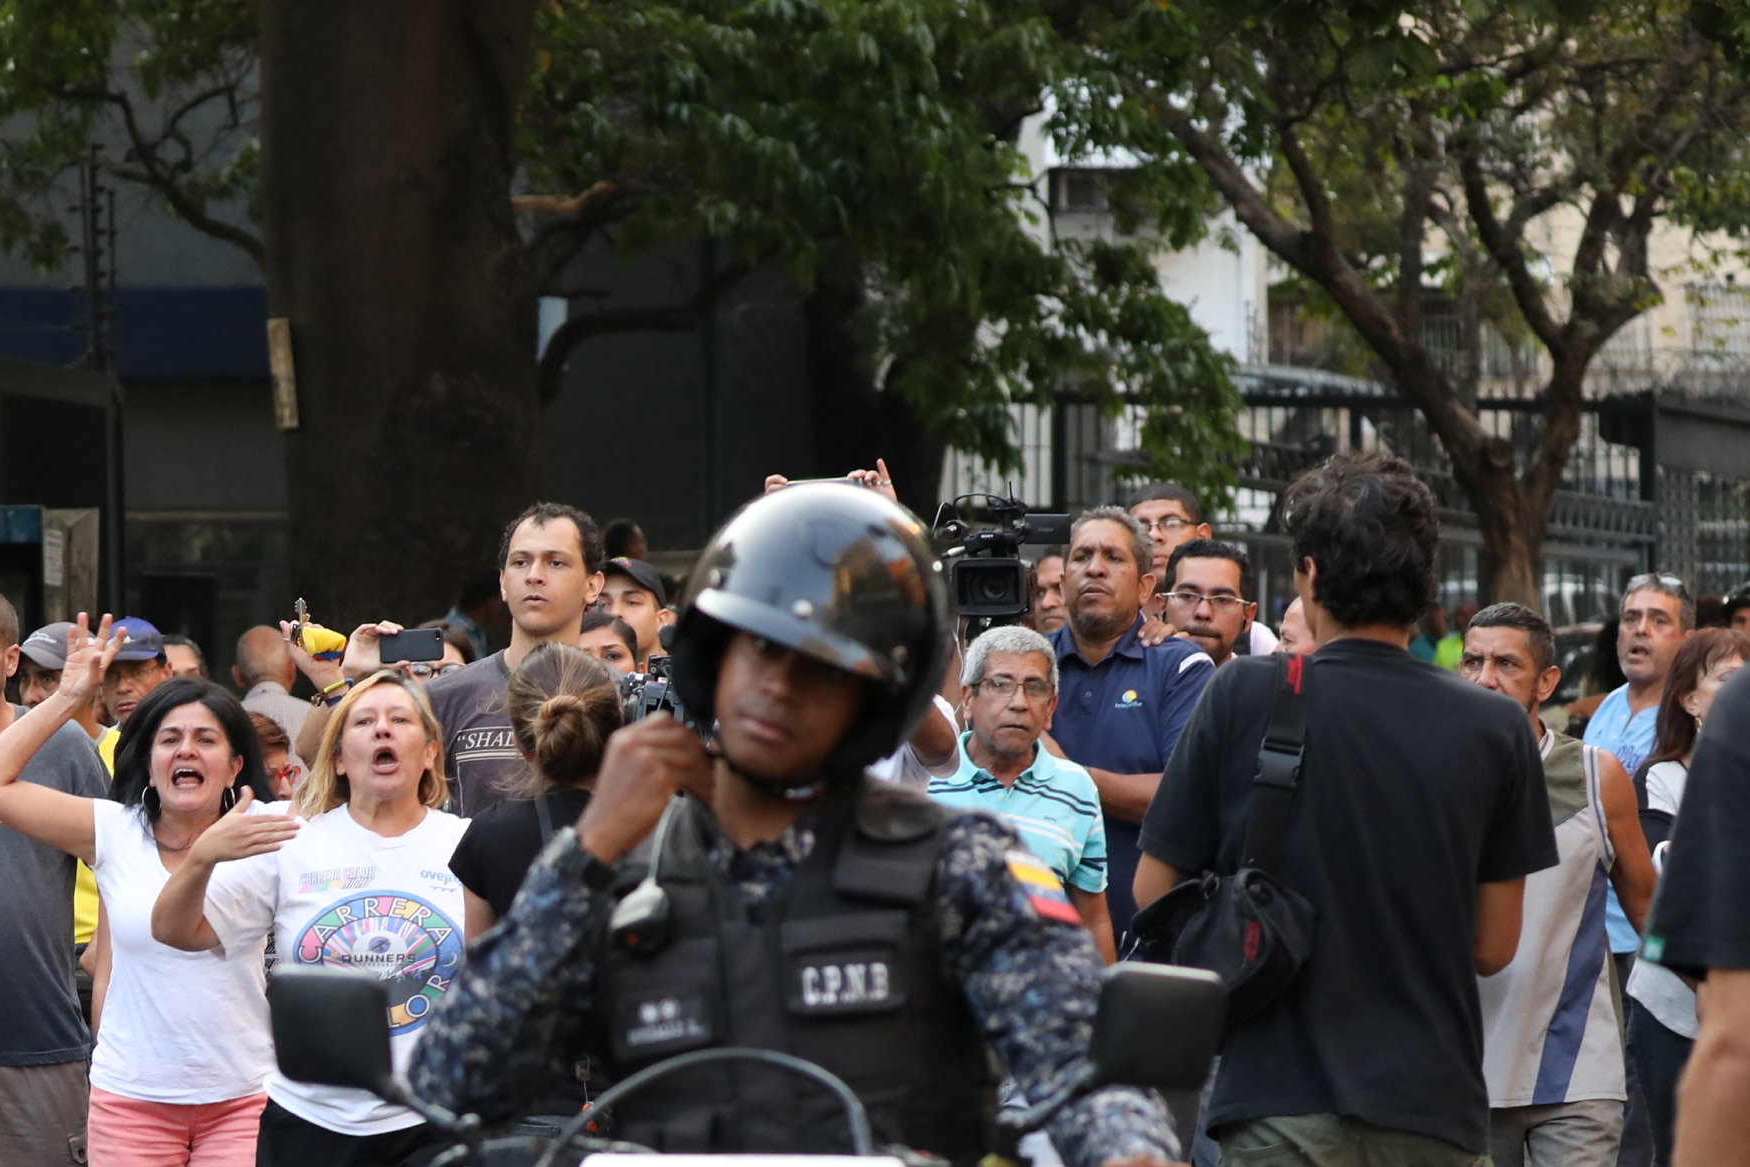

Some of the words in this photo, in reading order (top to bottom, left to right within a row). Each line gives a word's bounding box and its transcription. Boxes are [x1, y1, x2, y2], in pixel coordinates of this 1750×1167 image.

[298, 897, 453, 964] CARRERA
[341, 953, 417, 964] RUNNERS
[386, 974, 451, 1029] LOR
